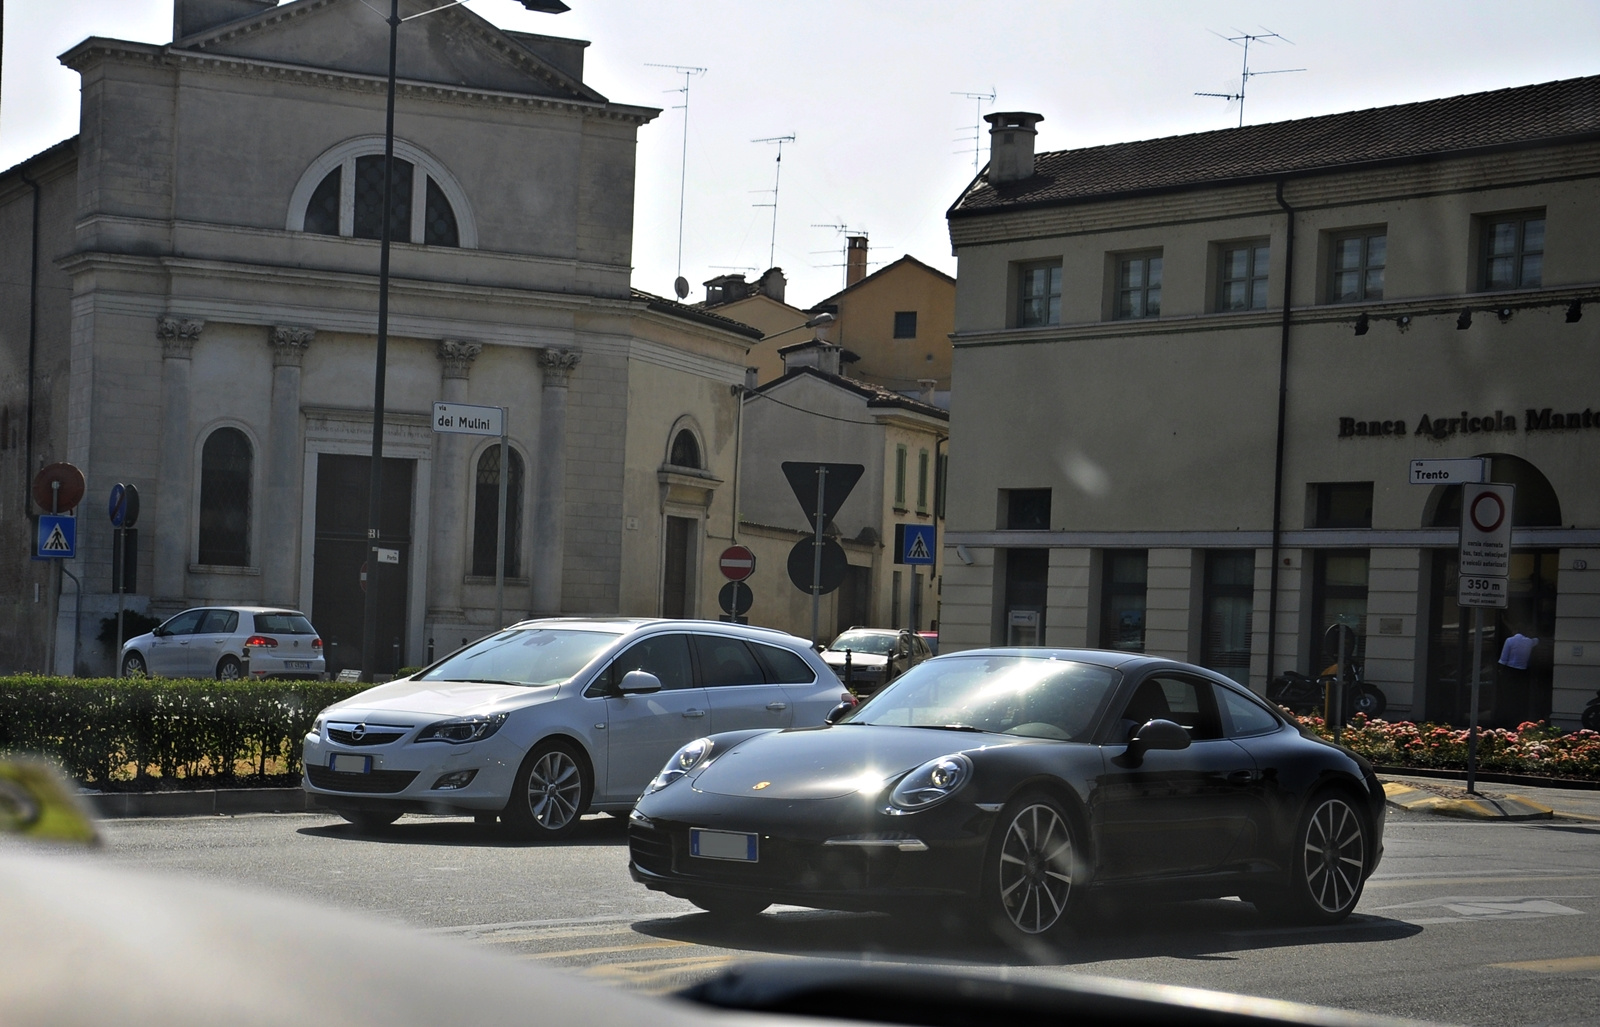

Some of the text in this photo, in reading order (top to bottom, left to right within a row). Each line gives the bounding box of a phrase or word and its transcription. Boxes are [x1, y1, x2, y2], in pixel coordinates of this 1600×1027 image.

[438, 415, 490, 430] dei Mulini
[1338, 416, 1406, 437] Banca
[1414, 410, 1517, 439] Agricola
[1415, 469, 1449, 480] Trento
[1467, 579, 1489, 590] 350
